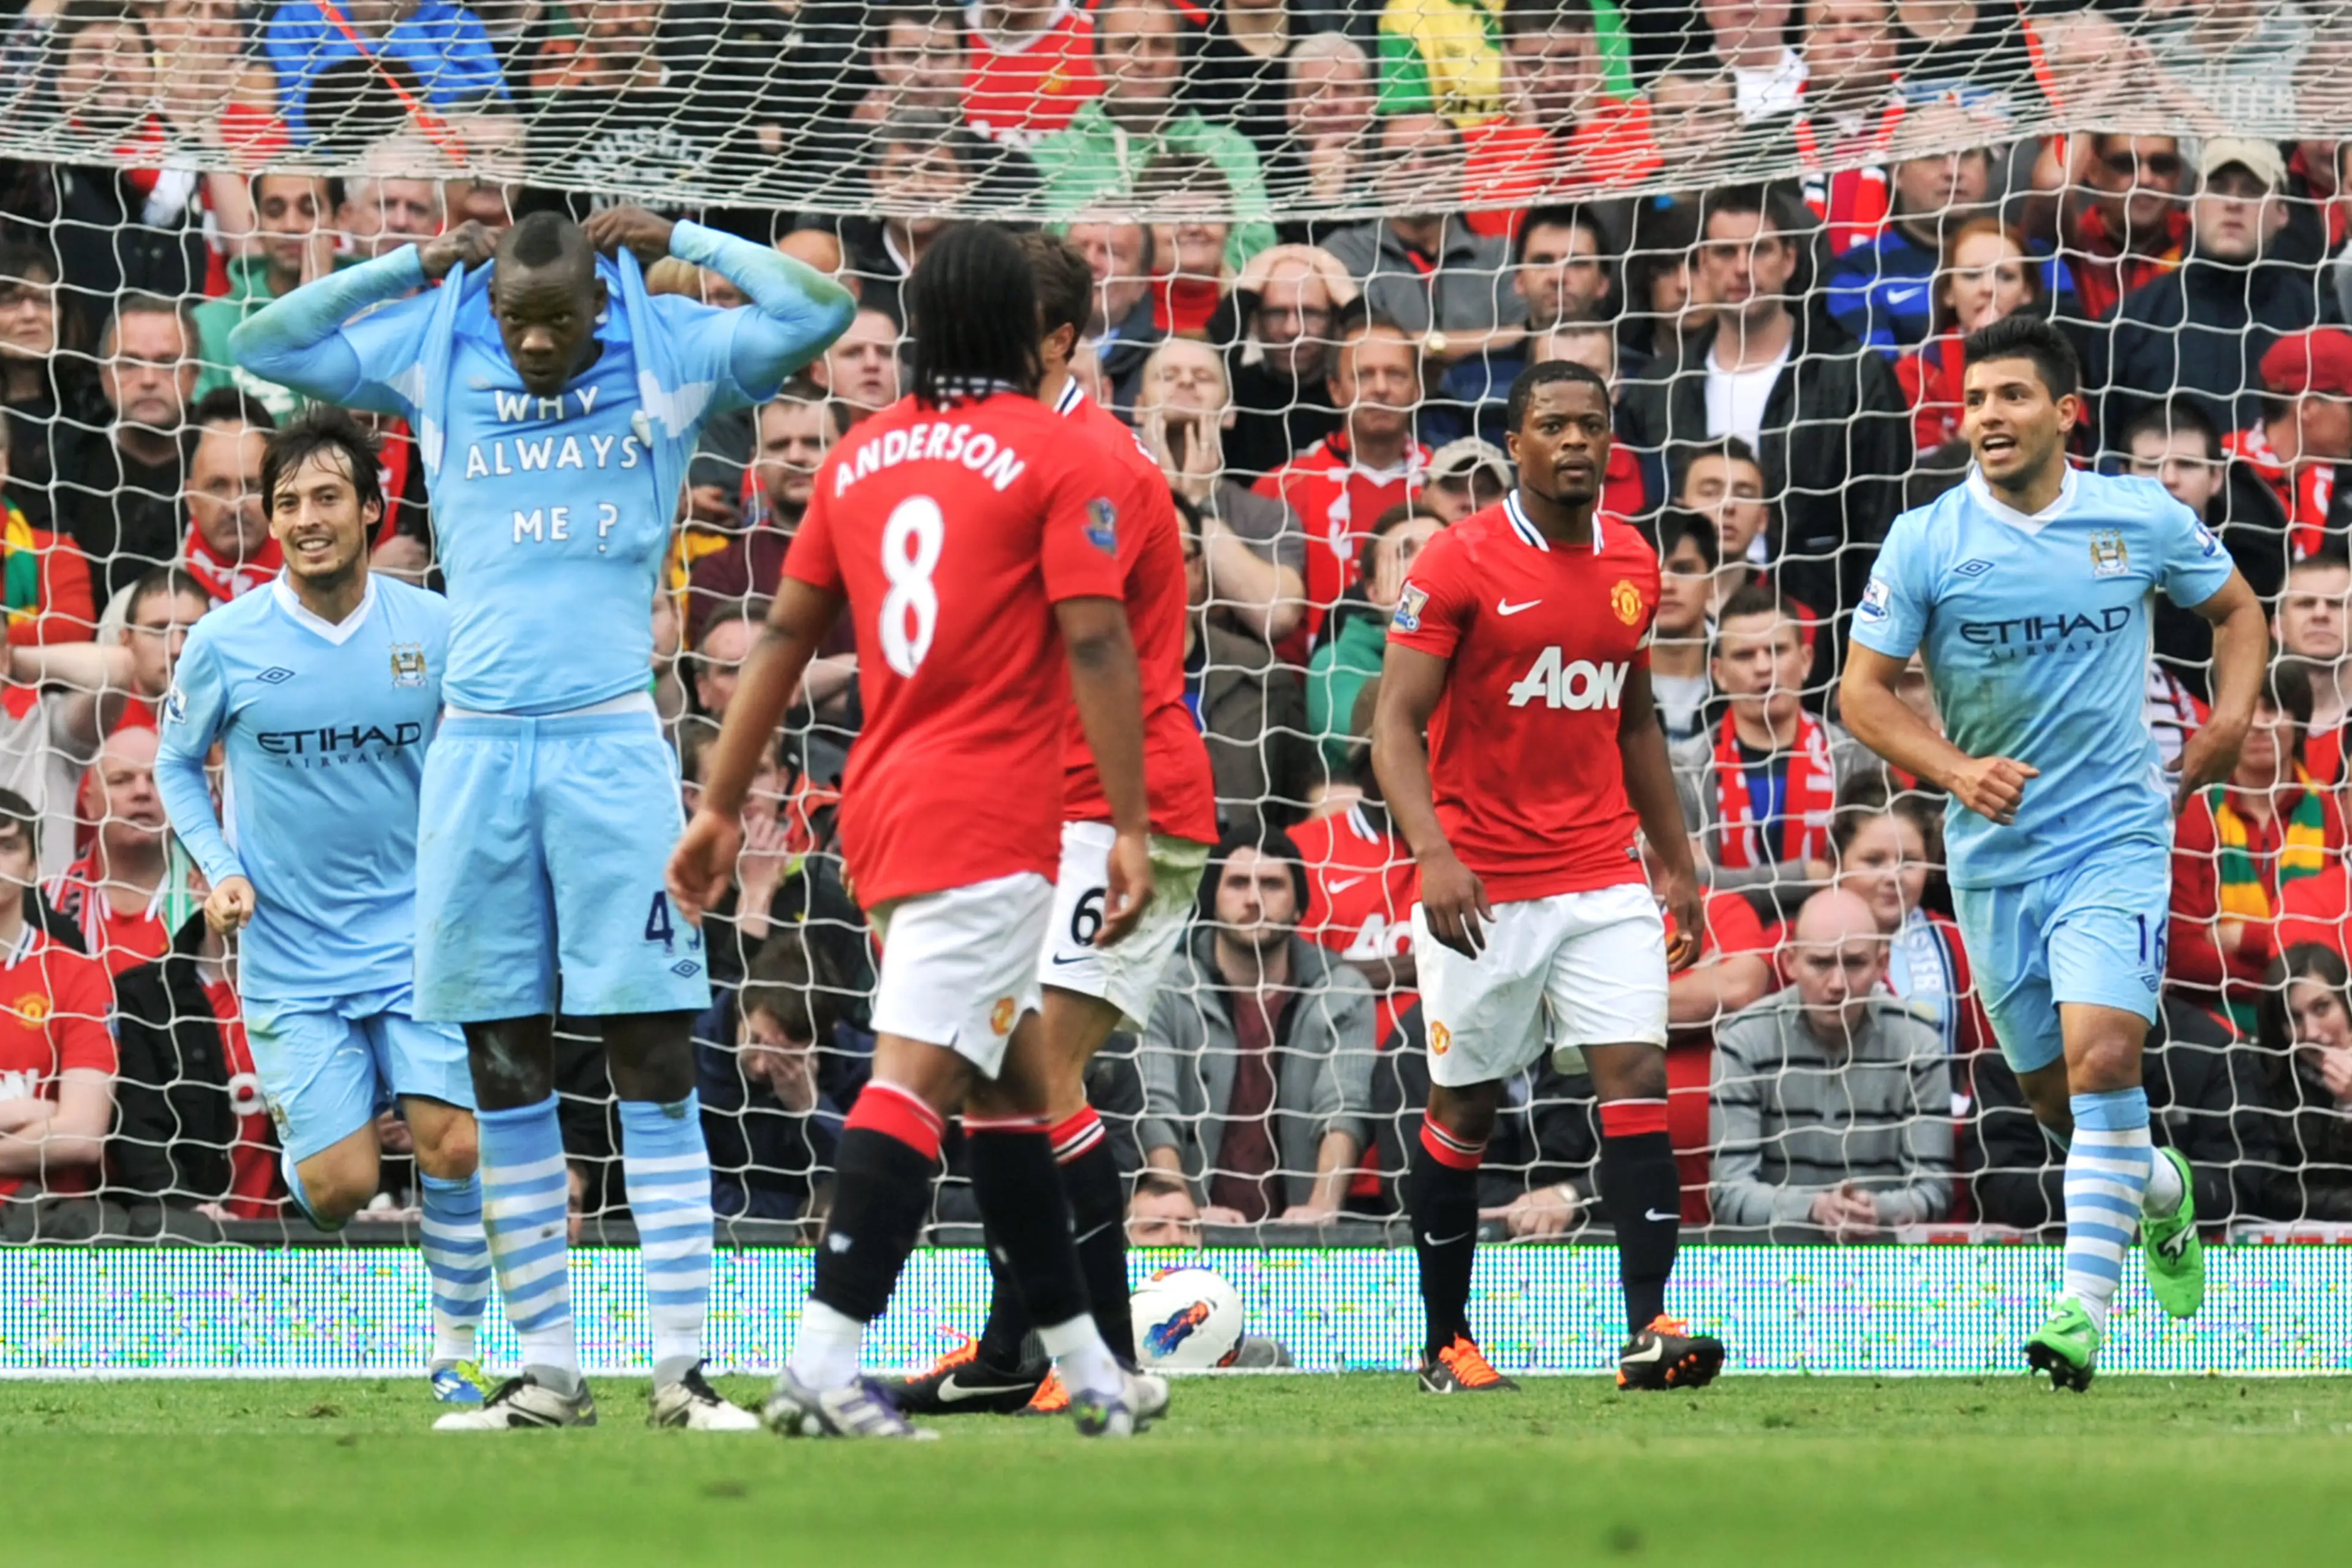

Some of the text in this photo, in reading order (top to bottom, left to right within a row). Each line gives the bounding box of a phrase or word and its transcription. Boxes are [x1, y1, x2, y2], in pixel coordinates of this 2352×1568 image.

[494, 385, 598, 422] WHY
[466, 434, 639, 481] ALWAYS
[834, 421, 1026, 498] ANDERSON
[513, 502, 619, 553] ME ?
[878, 494, 944, 679] 8
[1960, 605, 2132, 645] ETIHAD
[1507, 645, 1630, 710] AON
[257, 722, 421, 754] ETIHAD
[1071, 888, 1107, 946] 6
[1341, 913, 1415, 960] AO
